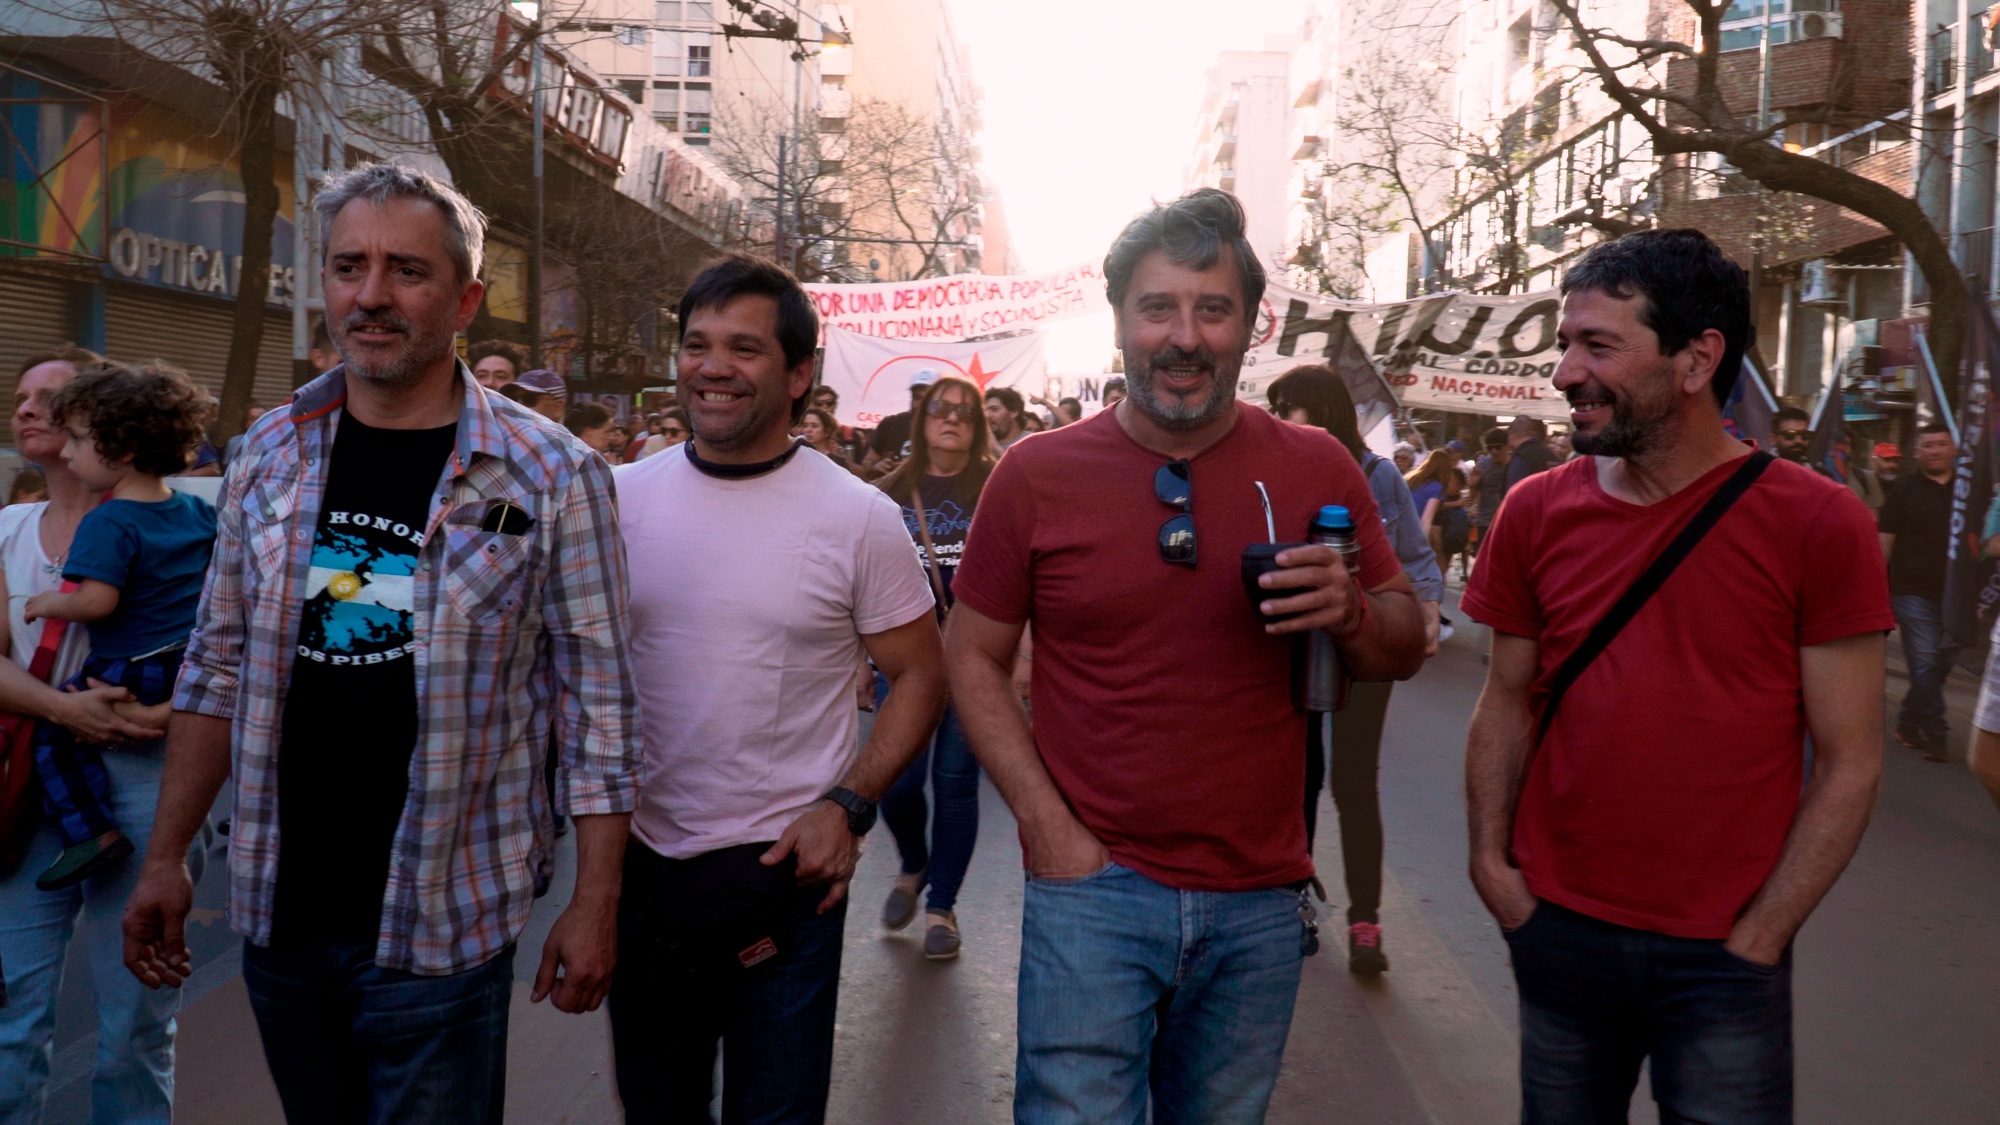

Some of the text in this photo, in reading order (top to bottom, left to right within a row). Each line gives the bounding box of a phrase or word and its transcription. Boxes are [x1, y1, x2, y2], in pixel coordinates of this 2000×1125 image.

[110, 228, 228, 294] OPTICA
[808, 290, 846, 317] POR
[849, 292, 887, 314] UNA
[893, 280, 1004, 311] DEMOCRACIA
[980, 289, 1086, 332] SOCIALISTA
[1430, 375, 1543, 400] NACIONAL
[330, 641, 417, 666] PIBES
